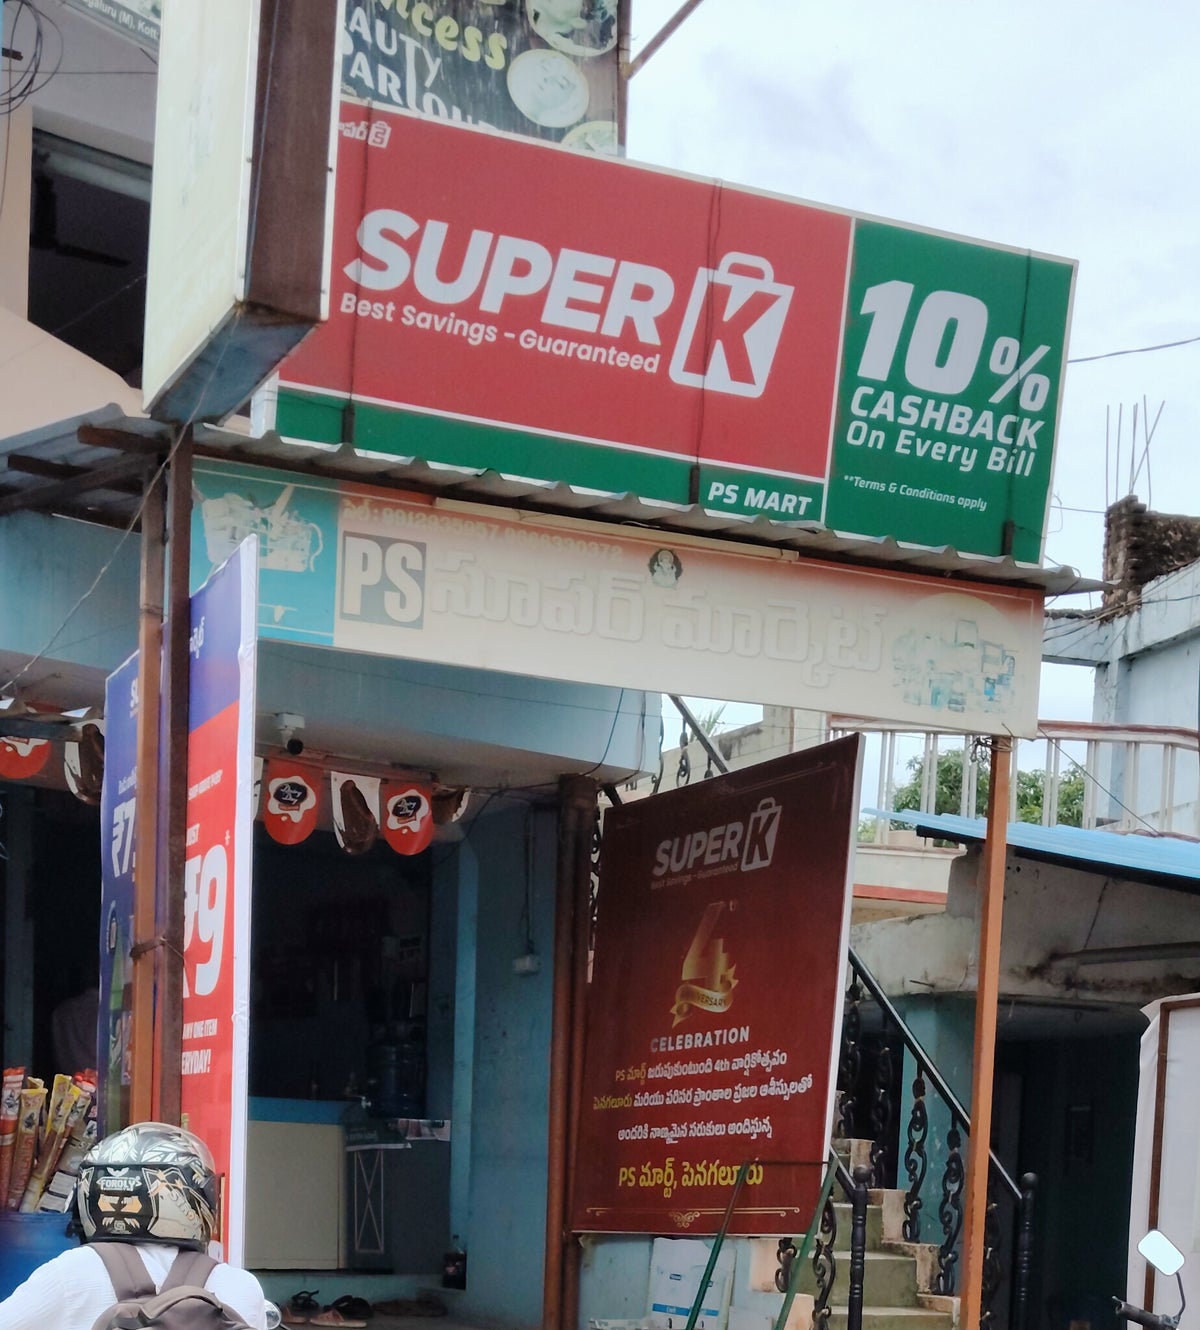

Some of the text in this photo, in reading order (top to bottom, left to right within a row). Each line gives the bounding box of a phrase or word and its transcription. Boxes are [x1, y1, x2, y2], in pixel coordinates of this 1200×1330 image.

[343, 208, 791, 394] SUPER K
[340, 292, 395, 322] Best
[401, 304, 498, 346] Savings
[519, 328, 660, 374] Guaranteed
[856, 279, 1051, 412] 10%
[850, 385, 1045, 449] CASHBACK
[846, 420, 1036, 477] On Every Bill
[708, 481, 812, 517] PS MART
[888, 482, 898, 494] &
[899, 484, 955, 504] Conditions
[957, 496, 988, 512] apply
[342, 536, 424, 624] PS
[652, 821, 744, 877] SUPER
[182, 1048, 212, 1075] ERYDAY!
[650, 1025, 749, 1053] CELEBRATION
[714, 1058, 730, 1072] 4th
[618, 1167, 636, 1187] PS
